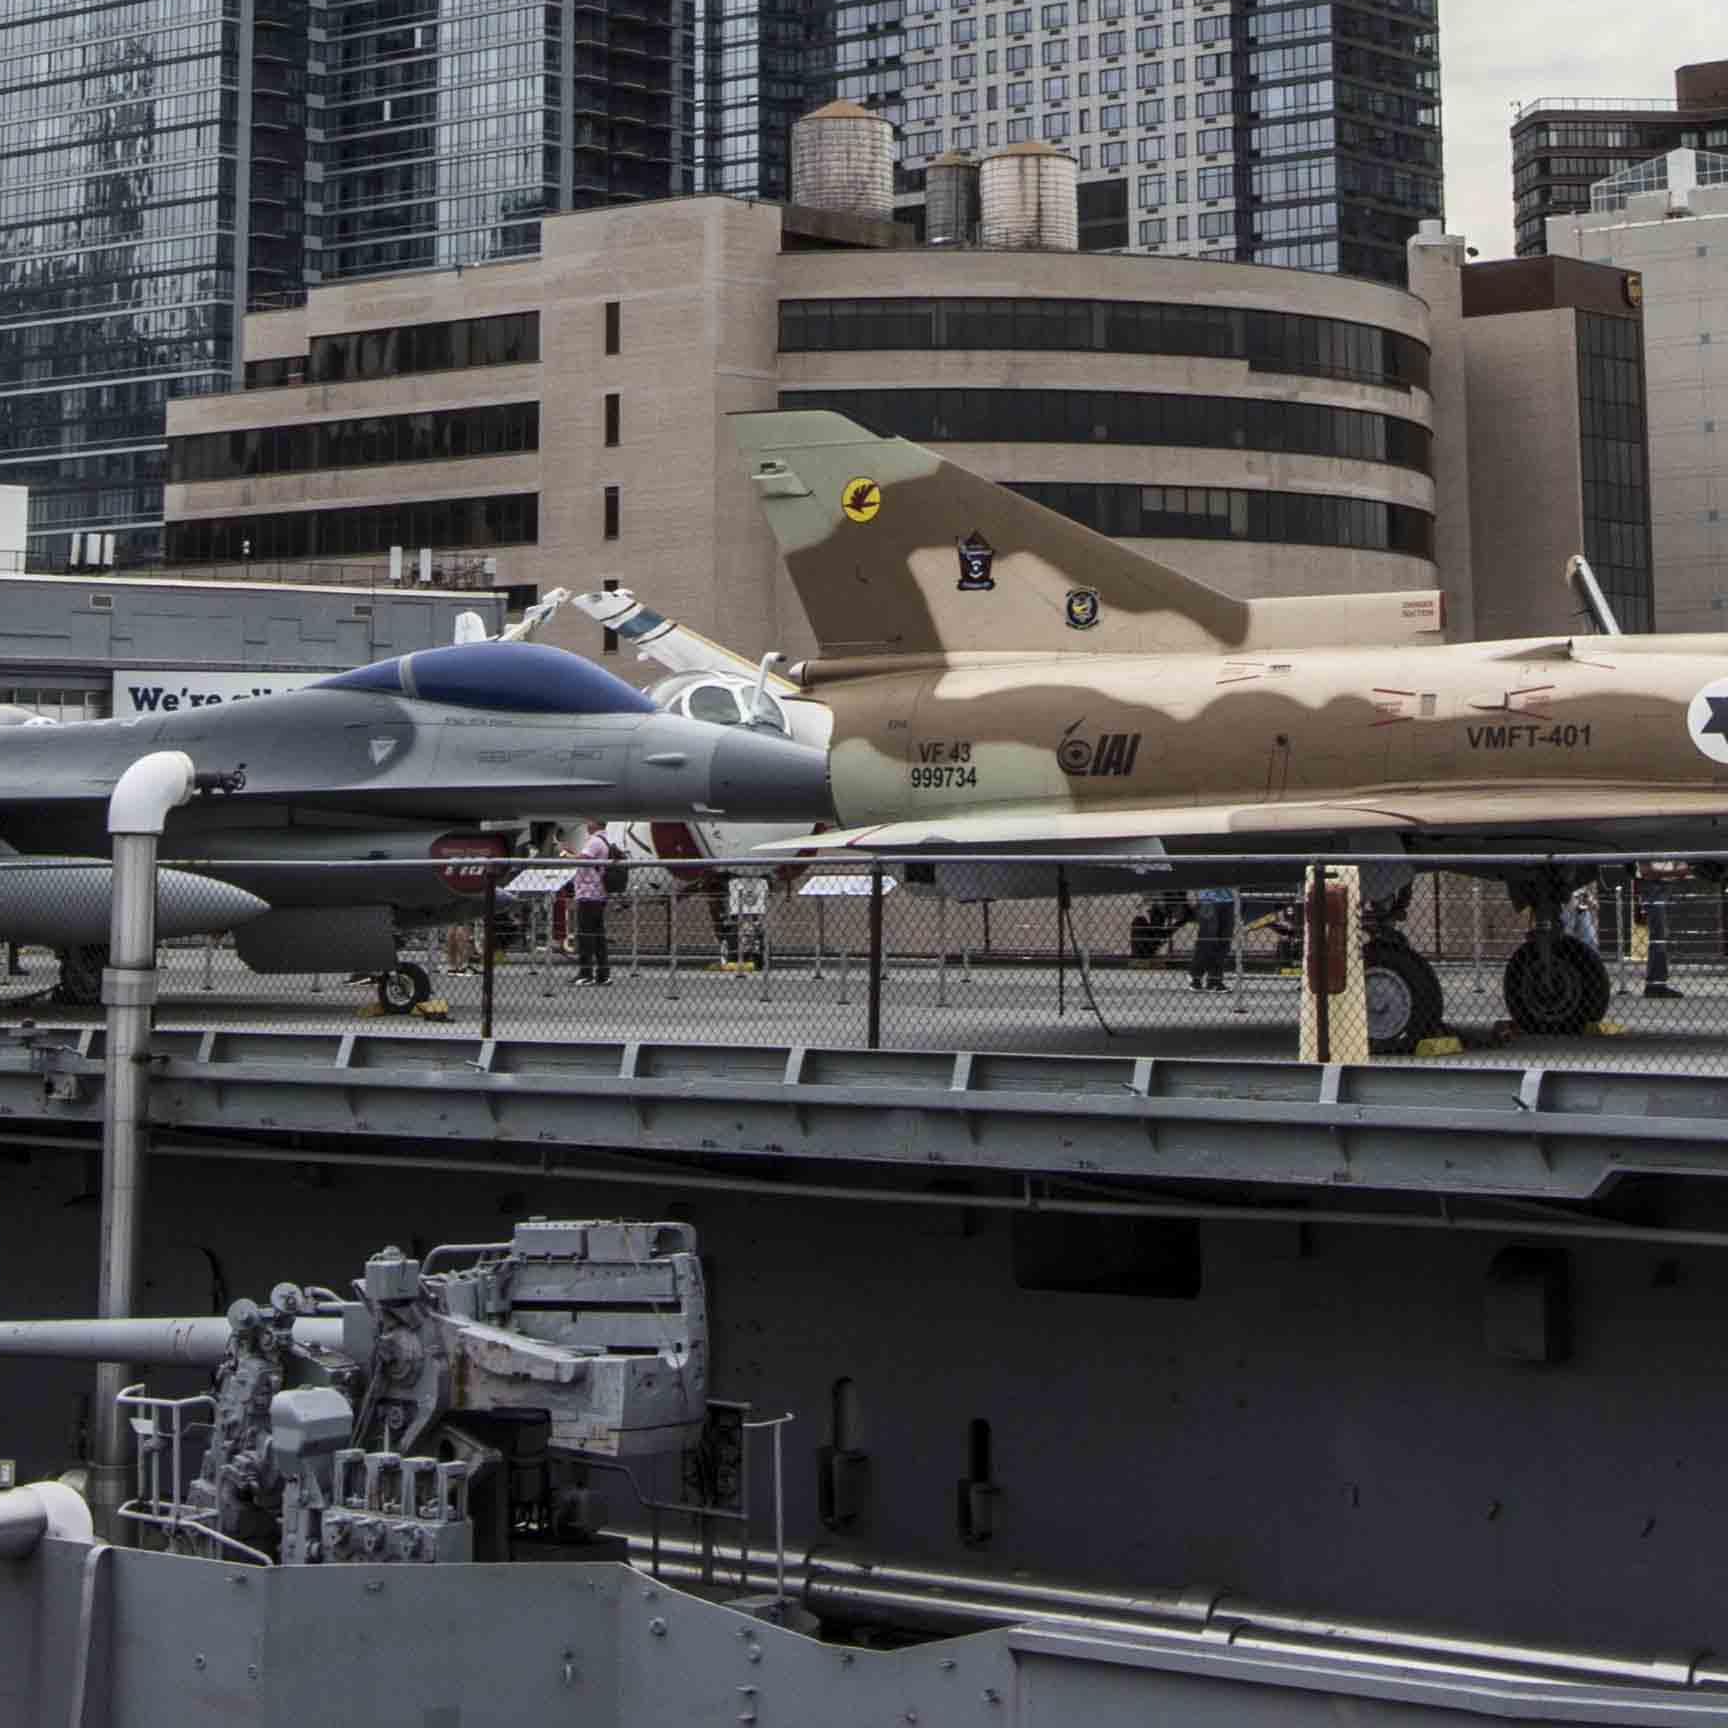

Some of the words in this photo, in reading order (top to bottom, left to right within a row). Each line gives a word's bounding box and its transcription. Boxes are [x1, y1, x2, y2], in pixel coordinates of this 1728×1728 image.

[128, 686, 223, 712] We're
[1466, 724, 1592, 750] VMFT-401
[919, 742, 945, 763] VF
[951, 742, 971, 763] 43
[1090, 732, 1143, 777] IAI
[910, 766, 977, 789] 999734
